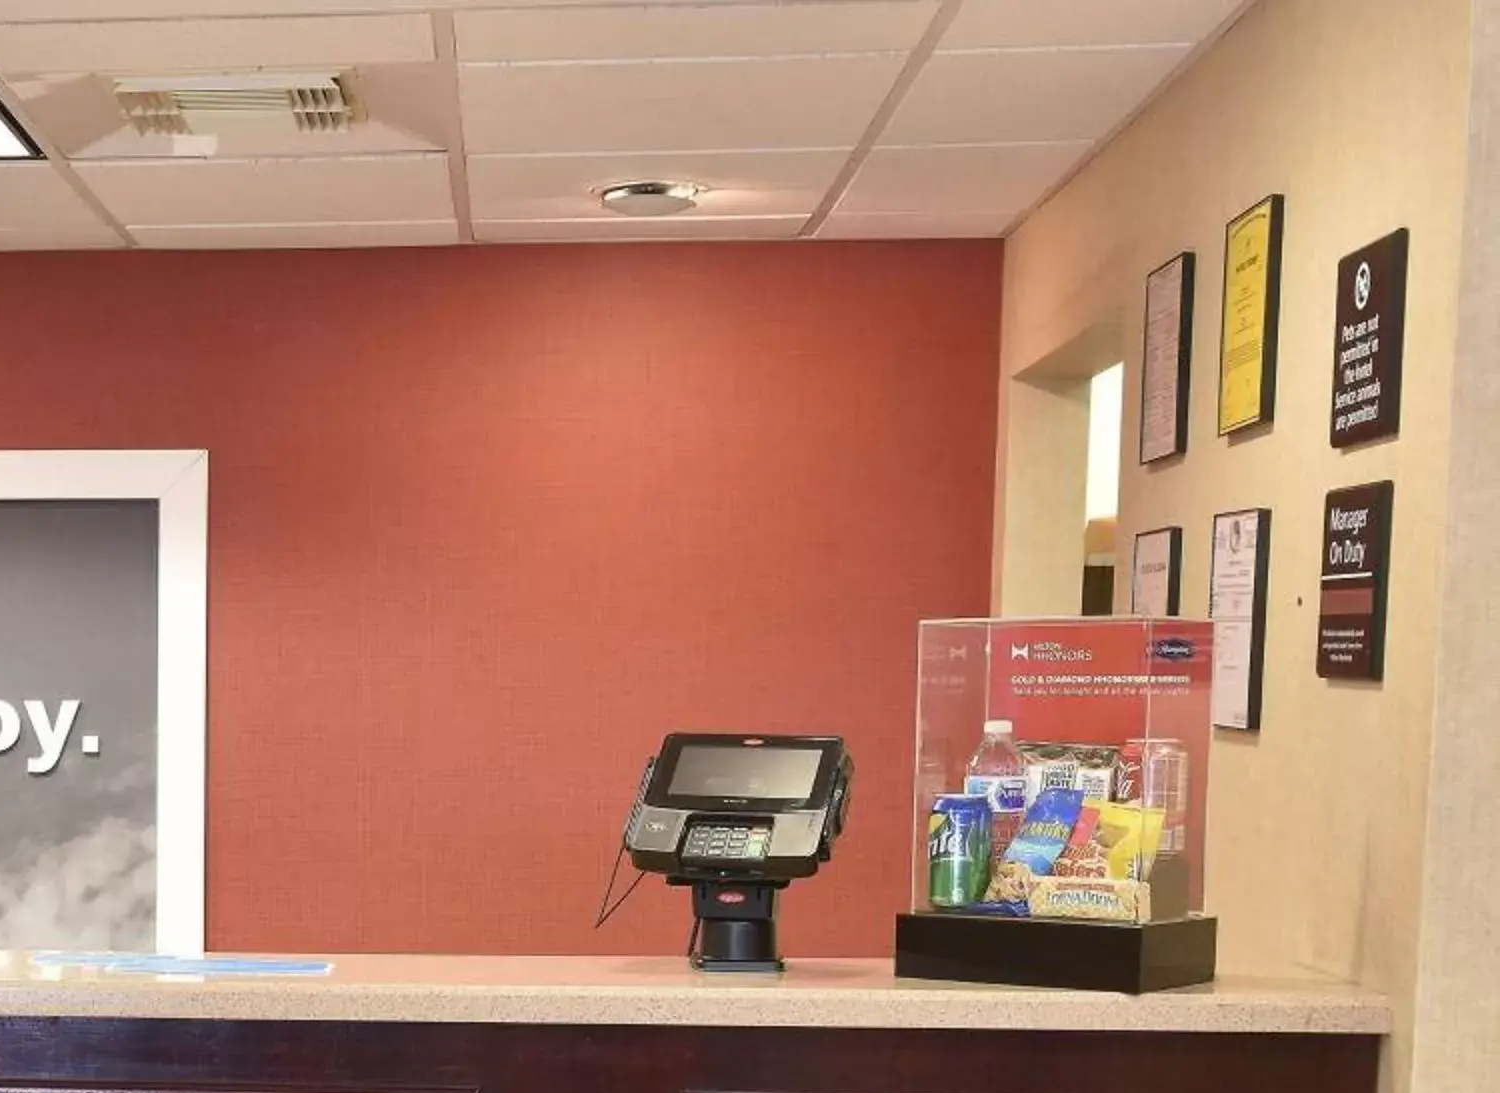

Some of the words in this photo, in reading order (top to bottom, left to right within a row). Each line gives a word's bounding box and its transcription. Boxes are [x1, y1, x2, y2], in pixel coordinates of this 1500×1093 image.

[1342, 323, 1355, 343] Pets
[1355, 321, 1367, 338] are
[1368, 313, 1380, 332] not
[1340, 340, 1371, 369] permitted
[1343, 365, 1355, 385] the
[1357, 377, 1381, 401] animals
[1335, 415, 1347, 431] are
[1330, 506, 1369, 535] Manager
[1329, 541, 1343, 565] On
[1344, 540, 1367, 569] Duty
